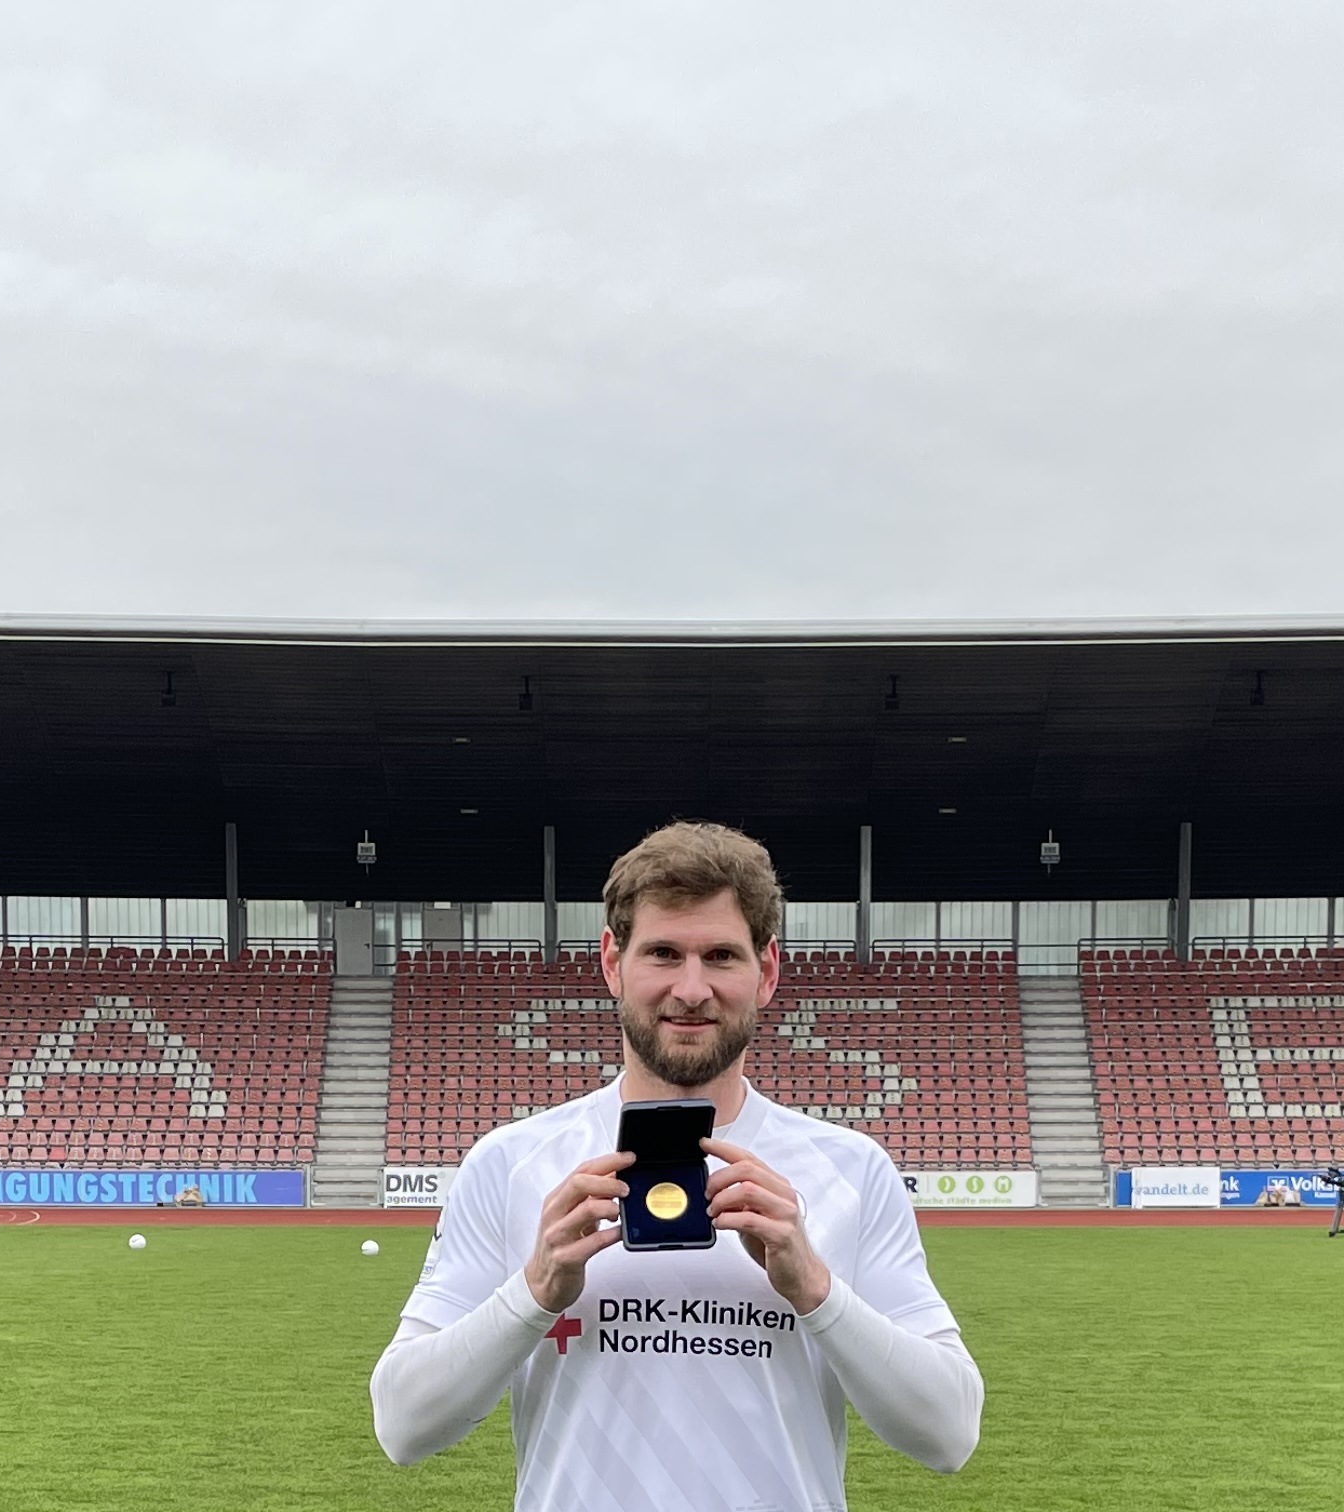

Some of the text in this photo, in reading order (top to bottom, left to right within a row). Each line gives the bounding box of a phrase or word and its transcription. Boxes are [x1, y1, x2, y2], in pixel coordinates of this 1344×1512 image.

[385, 1174, 439, 1193] DMS
[599, 1298, 796, 1331] DRK-Kliniken
[599, 1328, 773, 1358] Nordhessen
